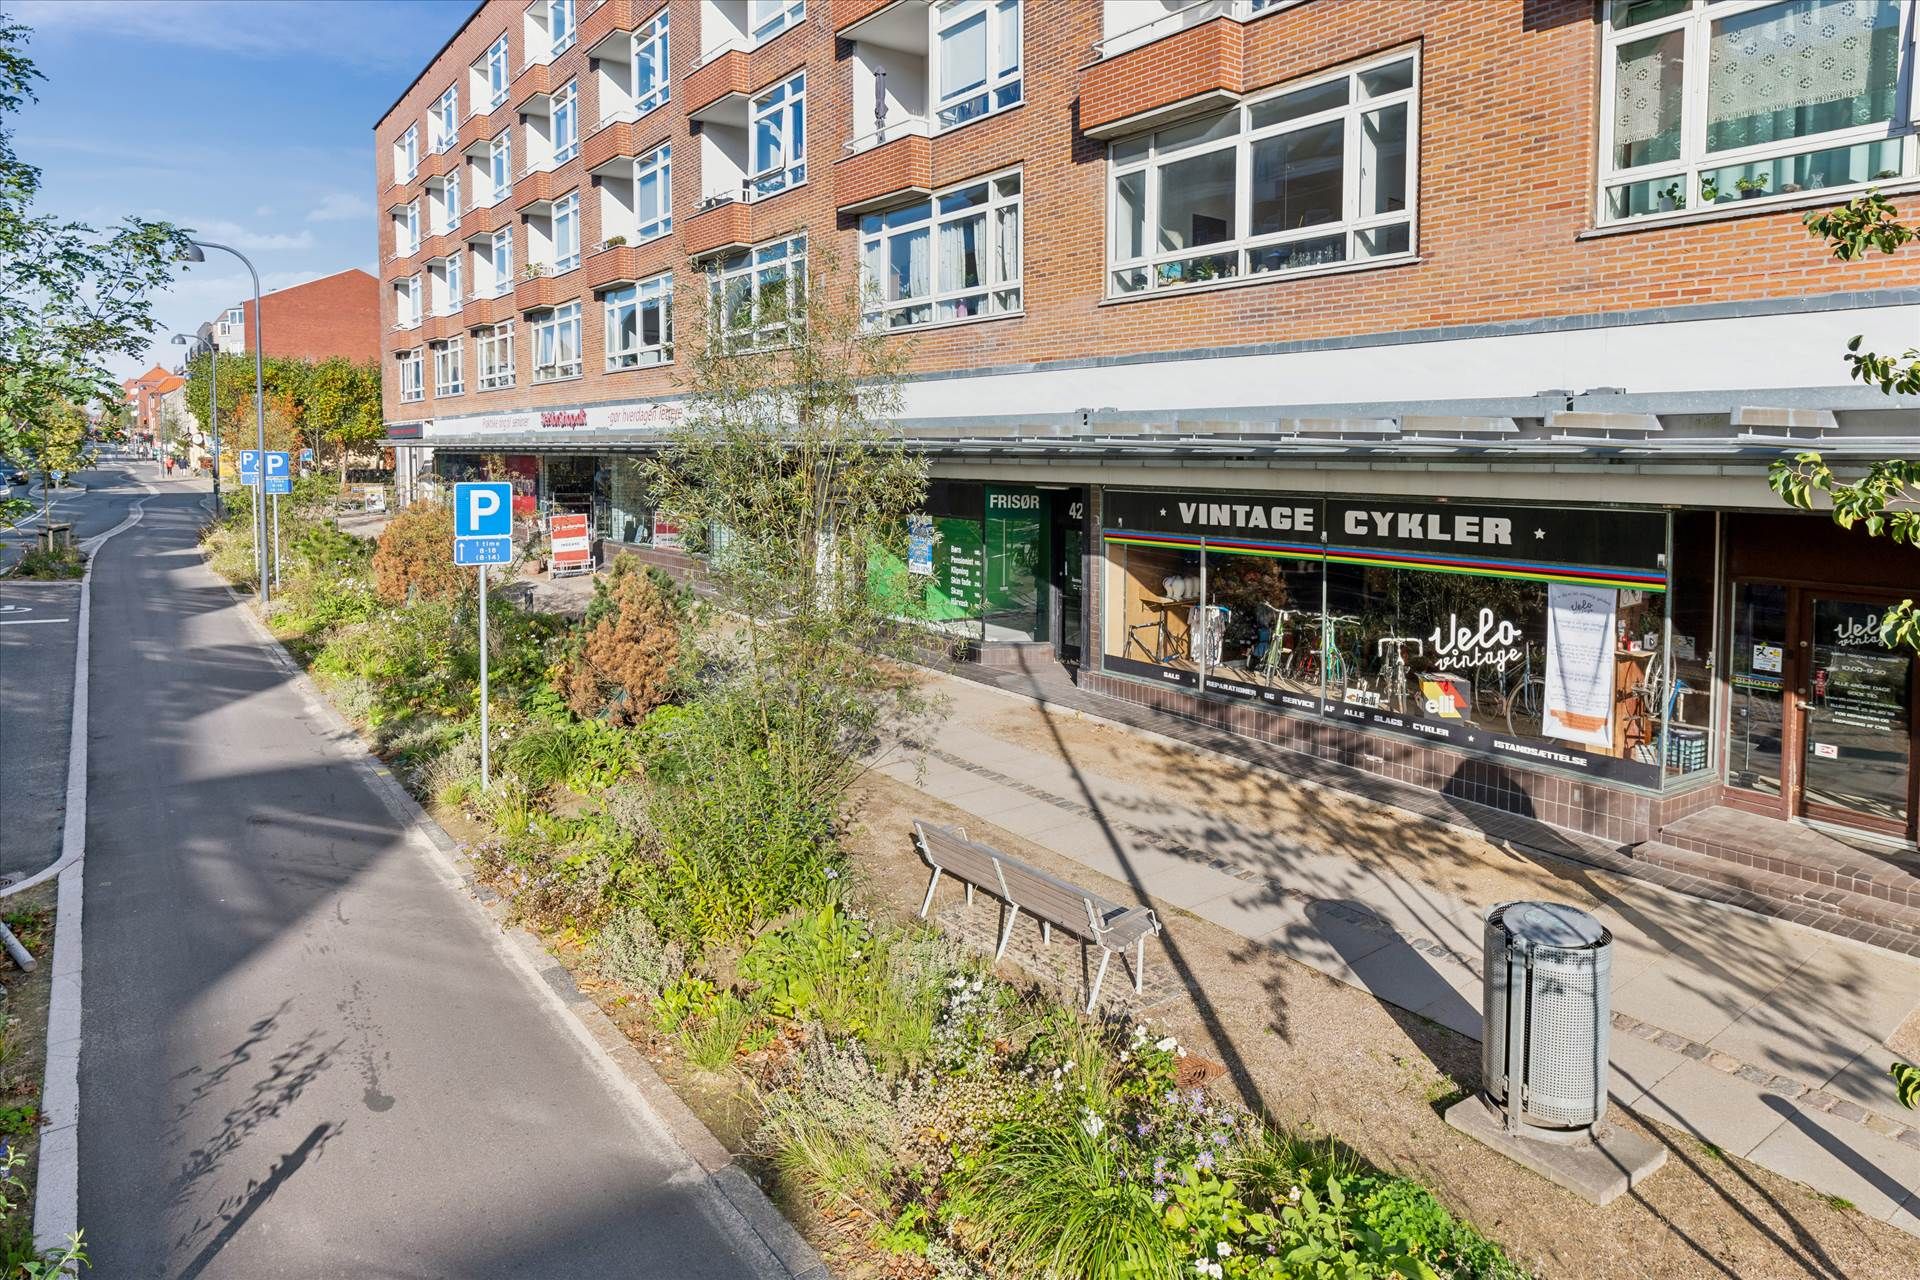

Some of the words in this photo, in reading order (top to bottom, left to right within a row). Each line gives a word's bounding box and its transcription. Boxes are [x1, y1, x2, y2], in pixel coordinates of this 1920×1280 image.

[243, 453, 254, 465] P
[267, 455, 284, 475] P
[470, 489, 500, 531] P
[989, 494, 1040, 510] FRISØR
[1069, 502, 1083, 520] 42
[1178, 502, 1314, 532] VINTAGE
[1344, 510, 1512, 545] CYKLER
[950, 566, 969, 577] Klipning
[950, 576, 961, 584] Skin
[1571, 600, 1593, 611] Velo
[1428, 608, 1522, 655] Velo
[1834, 614, 1881, 638] Vel
[1838, 634, 1884, 647] vintag
[1435, 646, 1523, 672] vintage
[1735, 676, 1780, 689] BENOTTO
[1206, 680, 1257, 697] REPARATIONER
[1264, 692, 1275, 700] OG
[1282, 696, 1315, 709] SERVICE
[1324, 704, 1336, 713] AF
[1344, 708, 1365, 719] ALLE
[1374, 715, 1403, 727] SLAGS
[1412, 723, 1450, 737] CYKLER
[1493, 739, 1588, 767] ISTANDSÆTTELSE
